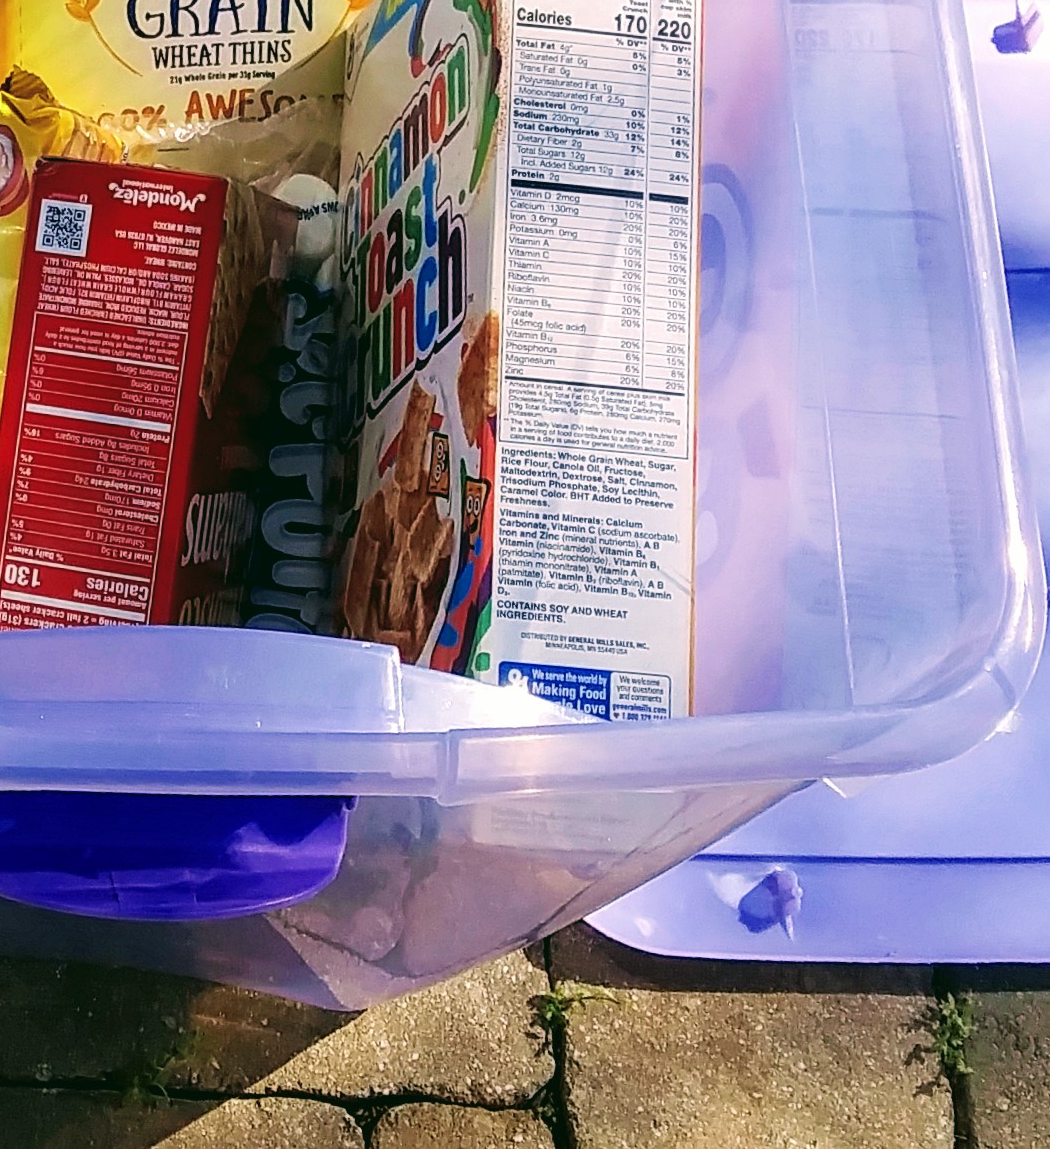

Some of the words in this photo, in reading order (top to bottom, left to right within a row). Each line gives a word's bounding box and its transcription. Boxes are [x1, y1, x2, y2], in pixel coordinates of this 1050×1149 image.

[517, 8, 573, 25] Calories
[614, 14, 647, 34] 170
[658, 20, 691, 39] 220
[516, 40, 538, 48] Total
[541, 42, 555, 50] Fat
[151, 42, 224, 69] WHEAT
[228, 39, 292, 66] THINS
[252, 70, 275, 80] Serving
[514, 98, 566, 110] Cholesterol
[570, 103, 588, 113] 0mg
[513, 110, 548, 121] Sodium
[552, 113, 580, 125] 230mg
[626, 122, 645, 130] 10%
[513, 122, 536, 131] Total
[538, 123, 600, 138] Carbohydrate
[604, 130, 619, 141] 33g
[625, 133, 645, 142] 12%
[511, 169, 545, 180] Protein
[550, 172, 560, 181] 2g
[122, 179, 174, 193] International
[510, 189, 542, 200] Vitamin
[556, 193, 580, 203] 2mcg
[625, 200, 643, 209] 10%
[153, 220, 175, 231] MEXICO
[510, 213, 526, 221] Iron
[531, 214, 558, 226] 3.6mg
[509, 224, 554, 236] Potassium
[559, 229, 578, 239] 0mg
[353, 152, 438, 328] Toast
[130, 429, 140, 438] 2g
[142, 432, 170, 443] Protein
[501, 447, 557, 459] Ingredients:
[558, 452, 586, 462] Whole
[589, 454, 613, 465] Grain
[615, 457, 646, 469] Wheat,
[648, 461, 677, 472] Sugar,
[105, 493, 130, 505] 170mg
[132, 499, 161, 510] Sodium
[97, 506, 113, 515] 0mg
[114, 510, 159, 523] Cholesterol
[101, 546, 118, 558] 3.5g
[120, 551, 132, 560] Fat
[134, 553, 153, 563] Total
[4, 564, 41, 588] 130
[86, 577, 150, 601] Calories
[497, 600, 547, 612] CONTAINS
[550, 604, 570, 614] SOY
[571, 606, 592, 616] AND
[594, 608, 628, 619] WHEAT
[497, 610, 566, 624] INGREDIENTS.
[532, 669, 545, 680] We
[545, 671, 564, 682] serve
[565, 672, 577, 682] the
[599, 676, 607, 687] by
[532, 683, 576, 700] Making
[580, 685, 606, 700] Food
